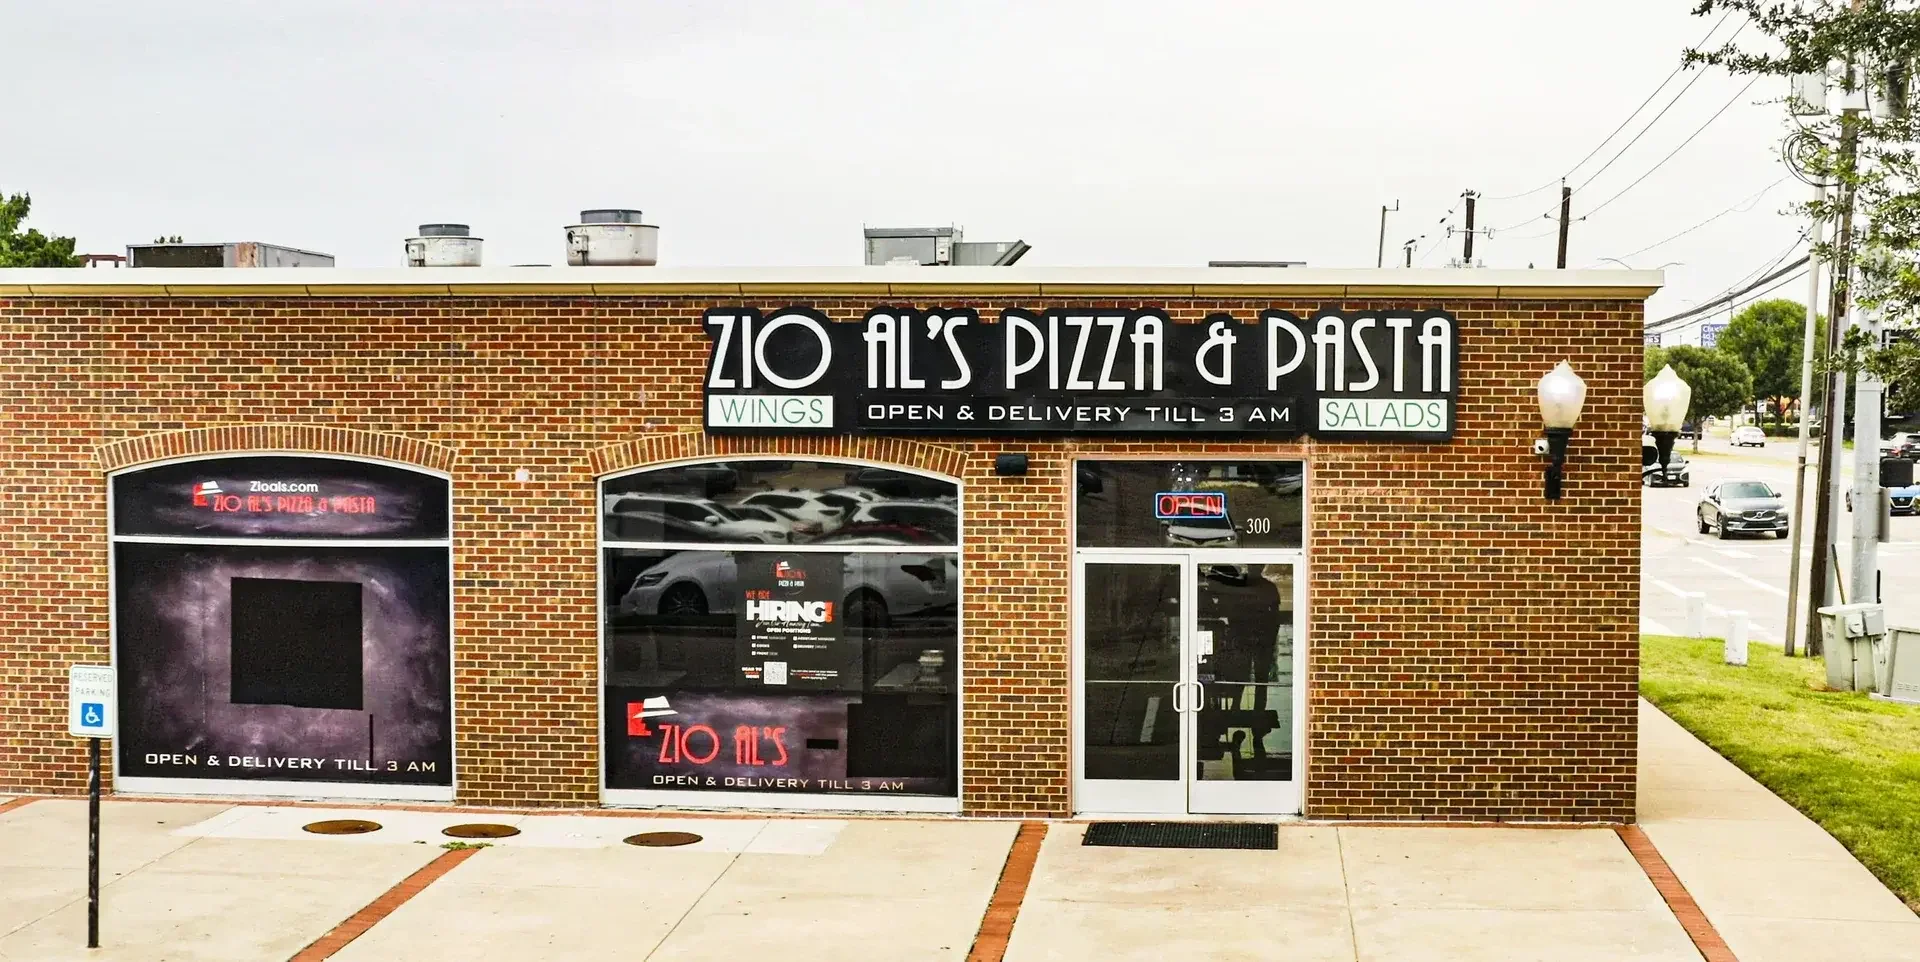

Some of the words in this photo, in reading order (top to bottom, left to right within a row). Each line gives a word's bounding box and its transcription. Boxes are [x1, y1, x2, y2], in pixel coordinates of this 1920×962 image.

[708, 314, 832, 389] ZIO
[863, 313, 972, 390] AL'S
[1005, 315, 1163, 391] PIZZA
[1195, 321, 1237, 385] &
[1267, 316, 1451, 392] PASTA
[719, 398, 824, 424] WINGS
[868, 404, 944, 420] OPEN
[956, 405, 975, 420] &
[988, 405, 1131, 421] DELIVERY
[1145, 407, 1205, 422] TILL
[1219, 407, 1234, 422] 3
[1248, 407, 1290, 422] AM
[1325, 401, 1441, 428] SALADS
[250, 481, 318, 493] Zioals.com
[213, 495, 242, 512] ZIO
[277, 496, 313, 513] PIZZA
[333, 496, 376, 513] PASTA
[1160, 496, 1221, 515] OPEN
[1246, 518, 1271, 534] 300
[746, 600, 833, 623] HIRING!
[73, 672, 113, 683] RESERVED
[658, 724, 721, 765] ZIO
[733, 725, 788, 766] AL'S
[145, 753, 197, 765] OPEN
[206, 755, 220, 766] &
[228, 756, 325, 769] DELIVERY
[334, 758, 378, 771] TILL
[387, 761, 398, 772] 3
[407, 761, 436, 772] AM
[653, 775, 699, 786] OPEN
[706, 776, 717, 786] &
[724, 777, 809, 788] DELIVERY
[818, 779, 853, 789] TILL
[861, 780, 871, 790] 3
[879, 781, 904, 790] AM
